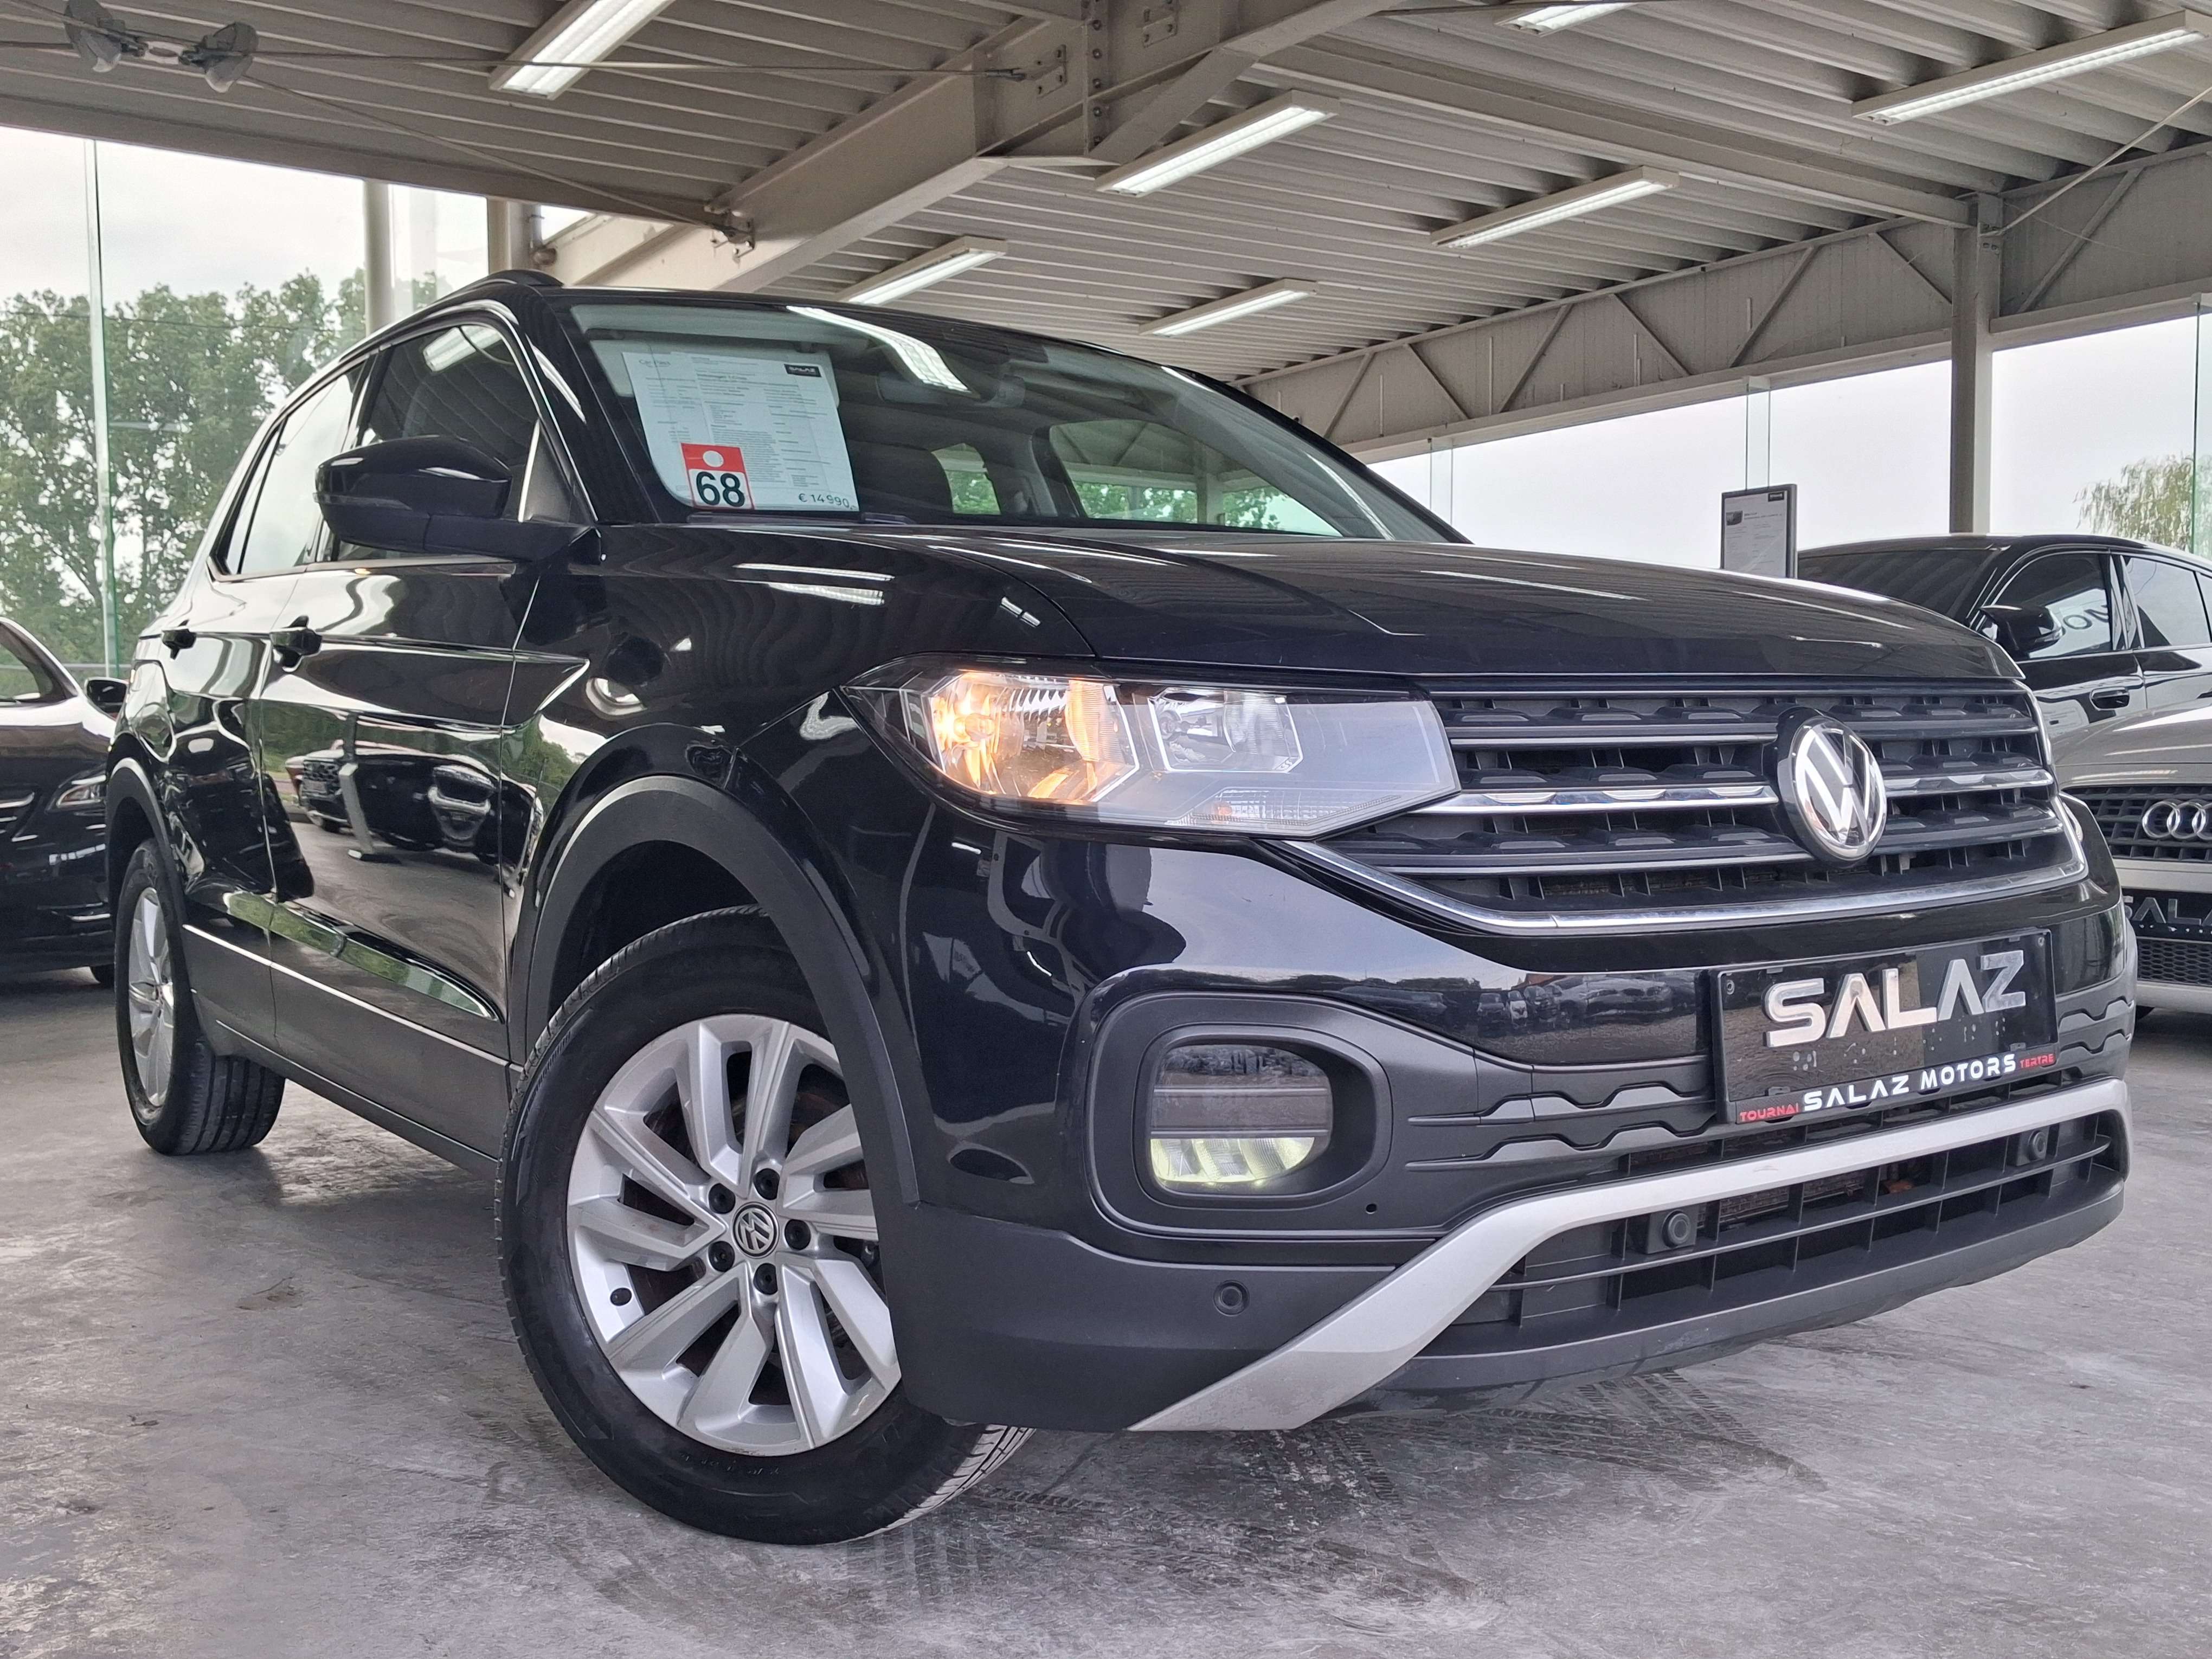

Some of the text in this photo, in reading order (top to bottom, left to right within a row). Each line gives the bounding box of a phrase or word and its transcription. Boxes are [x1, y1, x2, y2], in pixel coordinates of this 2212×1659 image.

[696, 471, 745, 507] 68
[2124, 895, 2212, 926] AL
[1764, 949, 2026, 1048] SALAZ
[1739, 1102, 1800, 1122] TOURNAI
[1804, 1075, 1910, 1111] SALAZ
[1920, 1053, 2017, 1091] MOTORS
